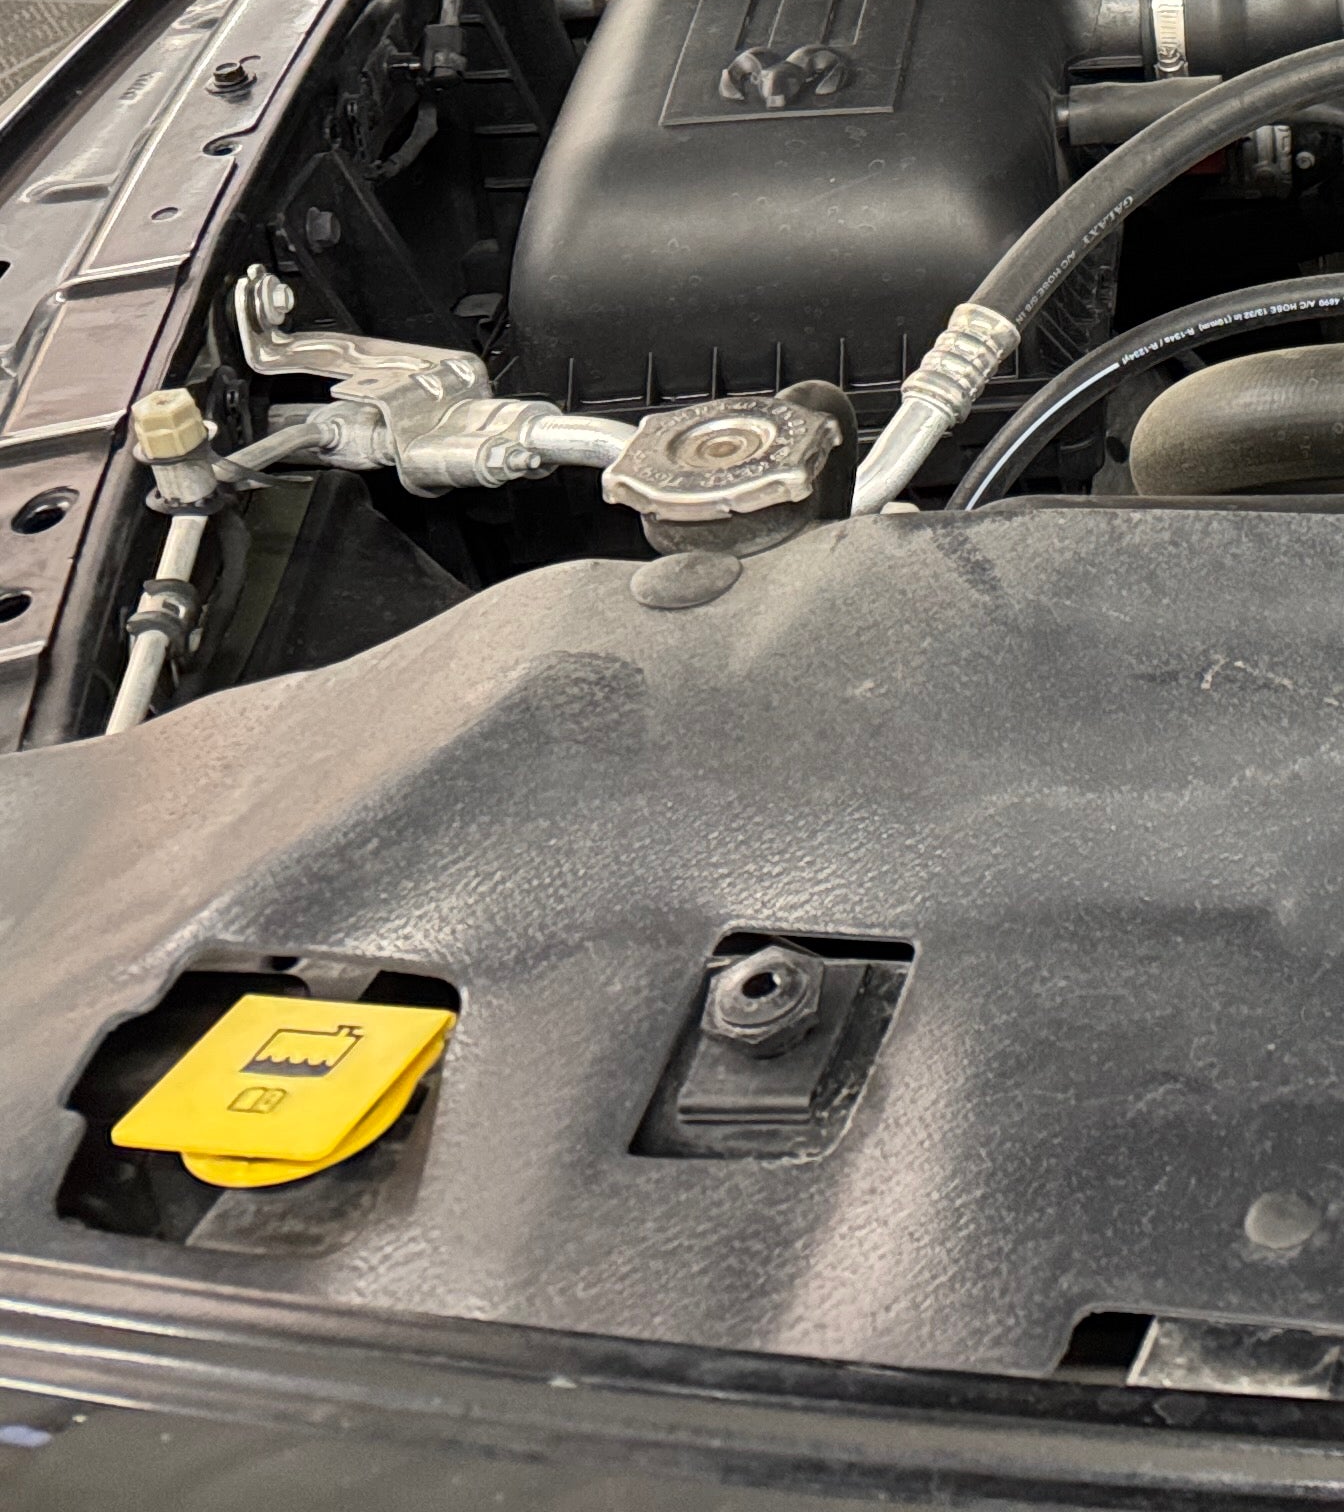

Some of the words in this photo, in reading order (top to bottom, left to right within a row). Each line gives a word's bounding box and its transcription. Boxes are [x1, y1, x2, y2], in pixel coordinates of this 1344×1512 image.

[1082, 195, 1133, 244] GALAXY
[1270, 303, 1298, 315] HOSE
[1299, 299, 1316, 310] A/C
[1121, 342, 1159, 365] R-1234yf
